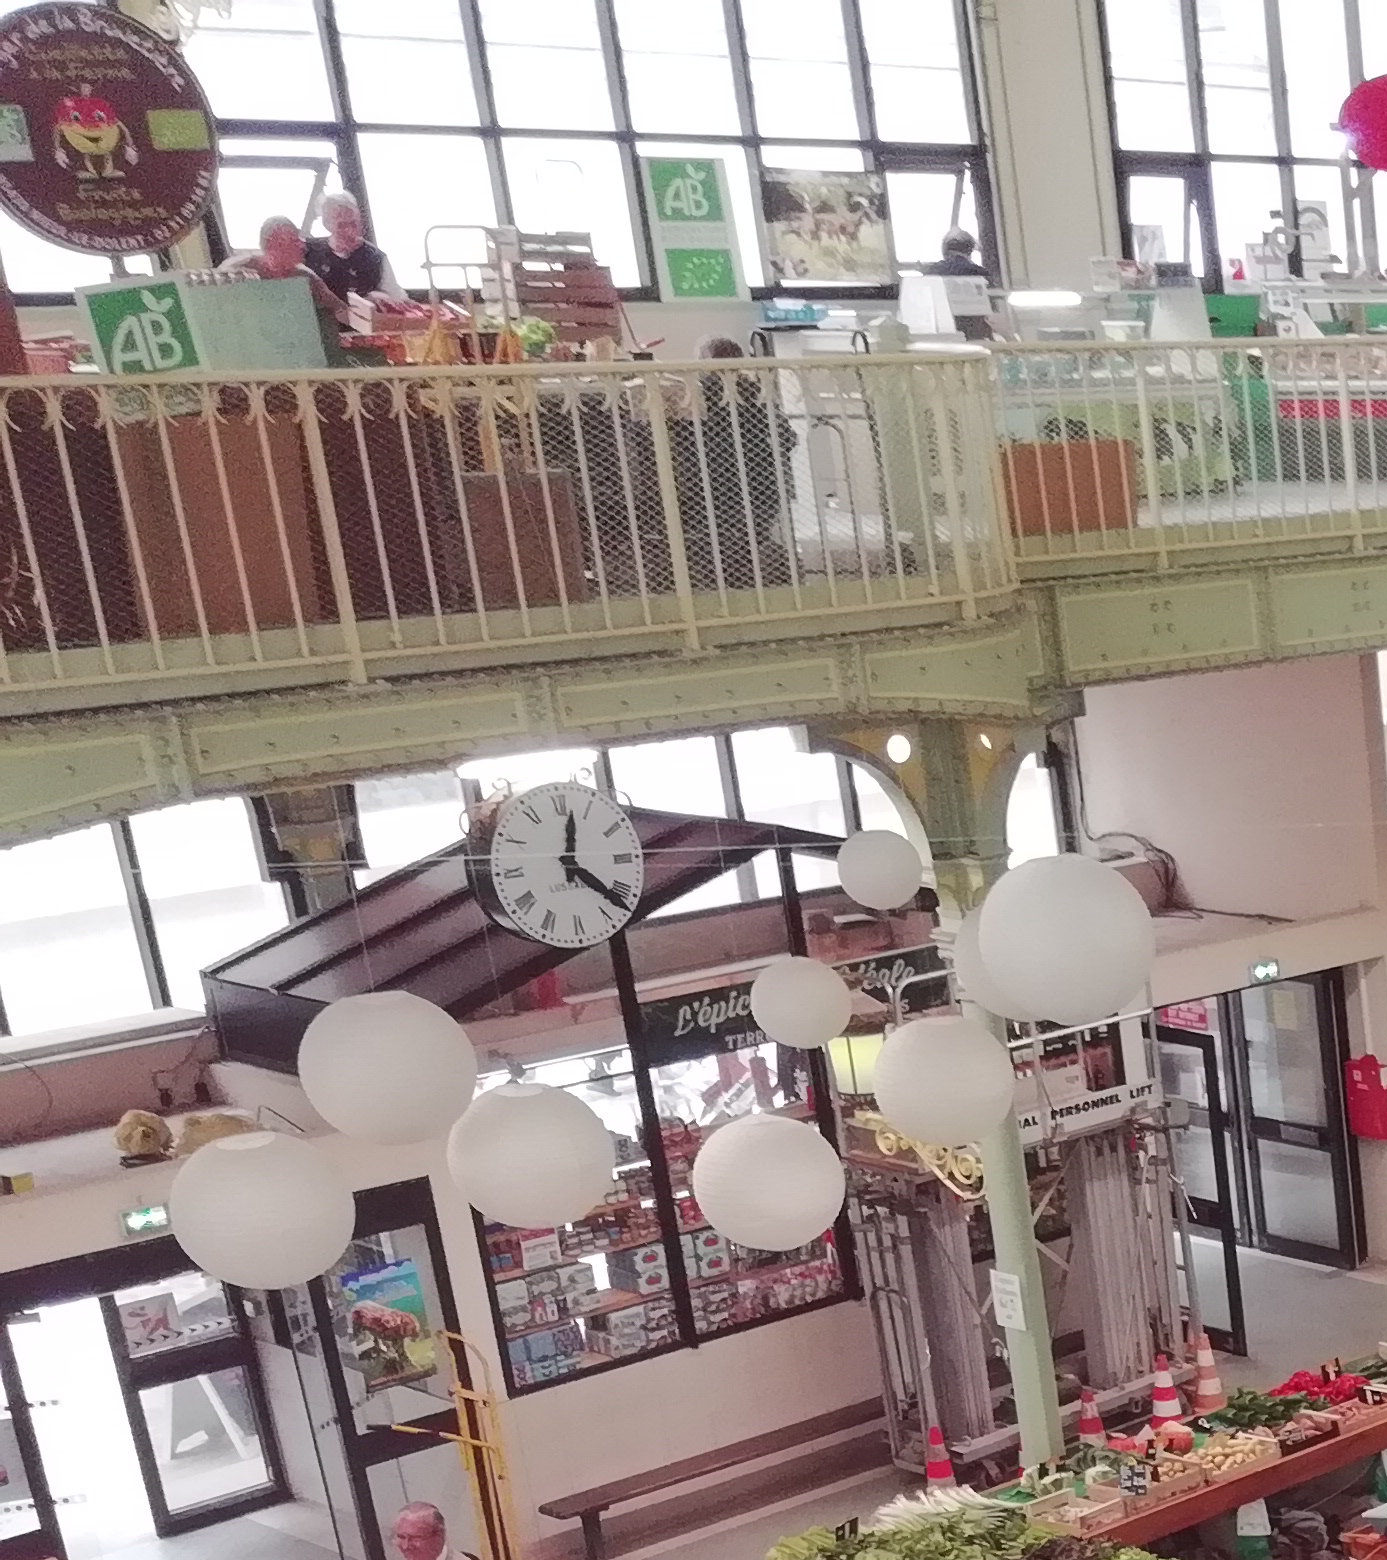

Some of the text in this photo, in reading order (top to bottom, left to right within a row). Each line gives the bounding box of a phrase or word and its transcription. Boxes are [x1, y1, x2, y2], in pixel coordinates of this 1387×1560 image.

[664, 177, 710, 217] AB
[110, 313, 184, 374] AB
[673, 989, 752, 1037] L'épic
[723, 1028, 771, 1050] TERR
[1050, 1092, 1123, 1121] PERSONNEL
[1128, 1083, 1154, 1101] LIFT
